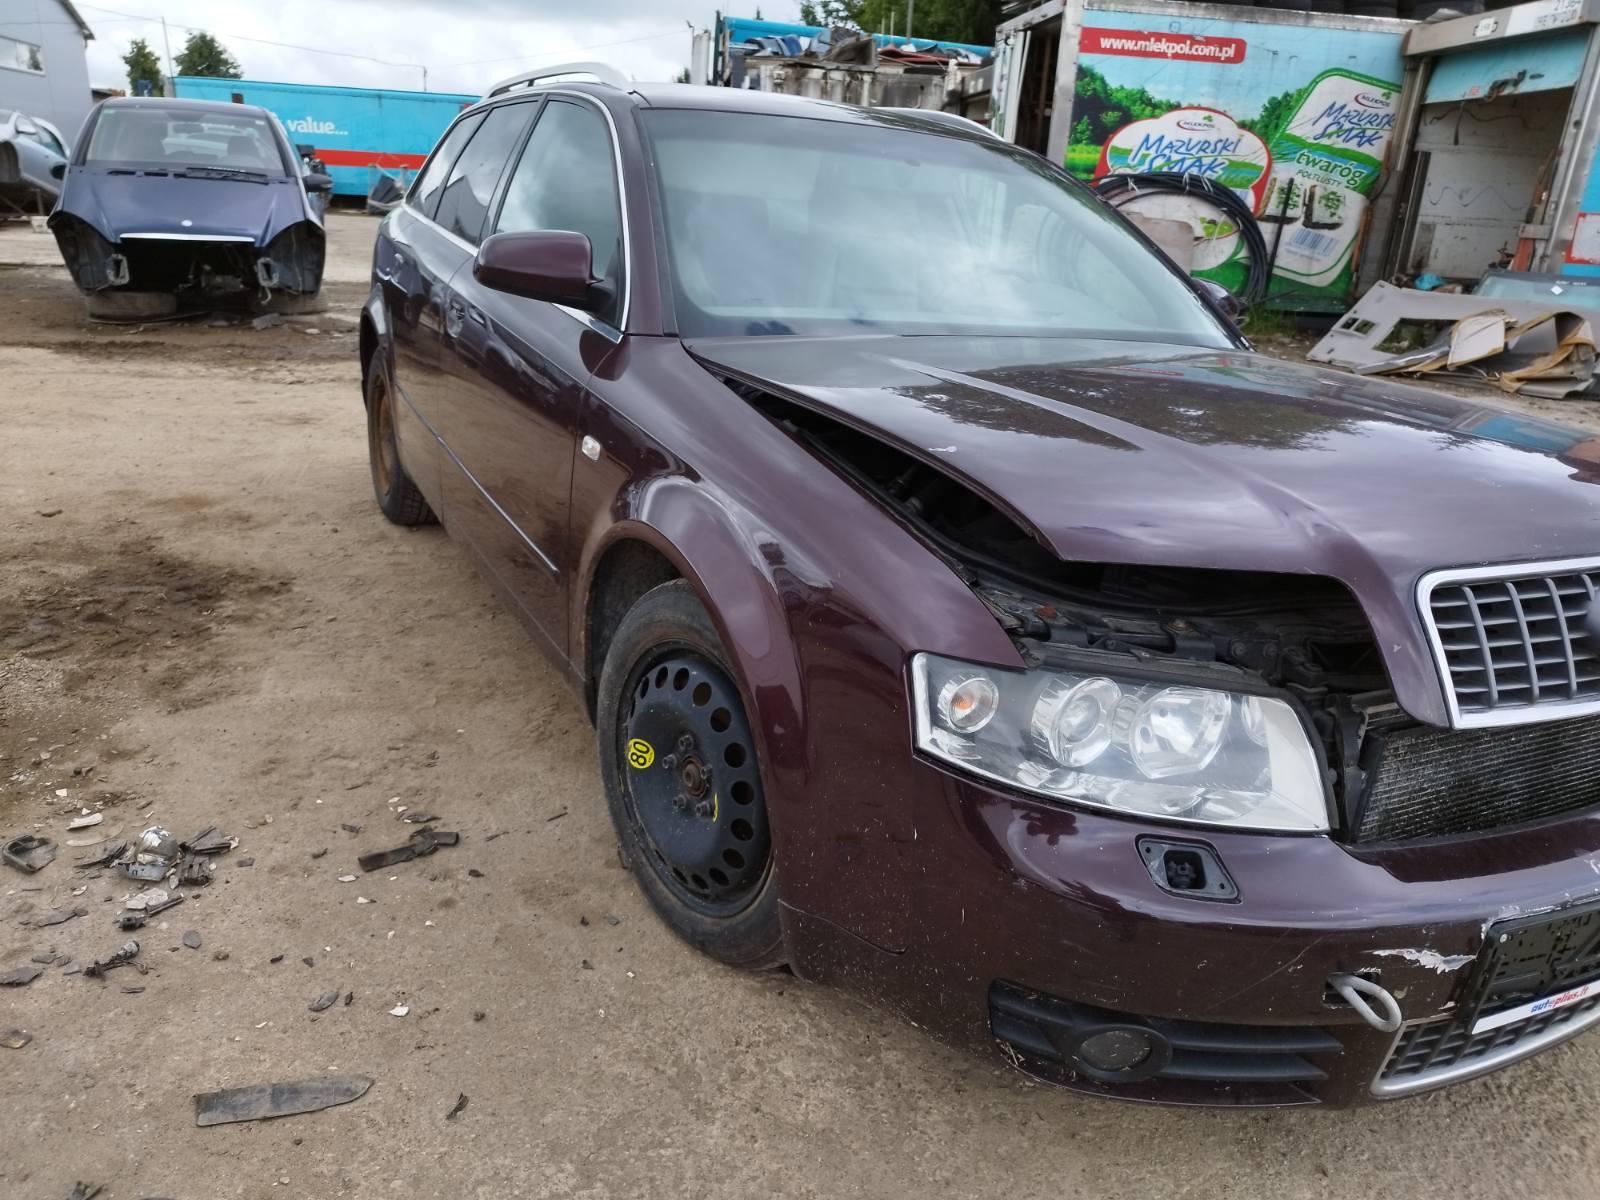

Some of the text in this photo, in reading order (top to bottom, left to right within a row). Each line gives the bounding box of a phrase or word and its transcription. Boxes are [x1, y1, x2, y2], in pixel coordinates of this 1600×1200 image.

[1100, 36, 1235, 60] www.mlekpol.com.pl
[1312, 101, 1395, 129] MAZURSK
[1296, 151, 1366, 187] twaróg
[630, 741, 650, 767] 80
